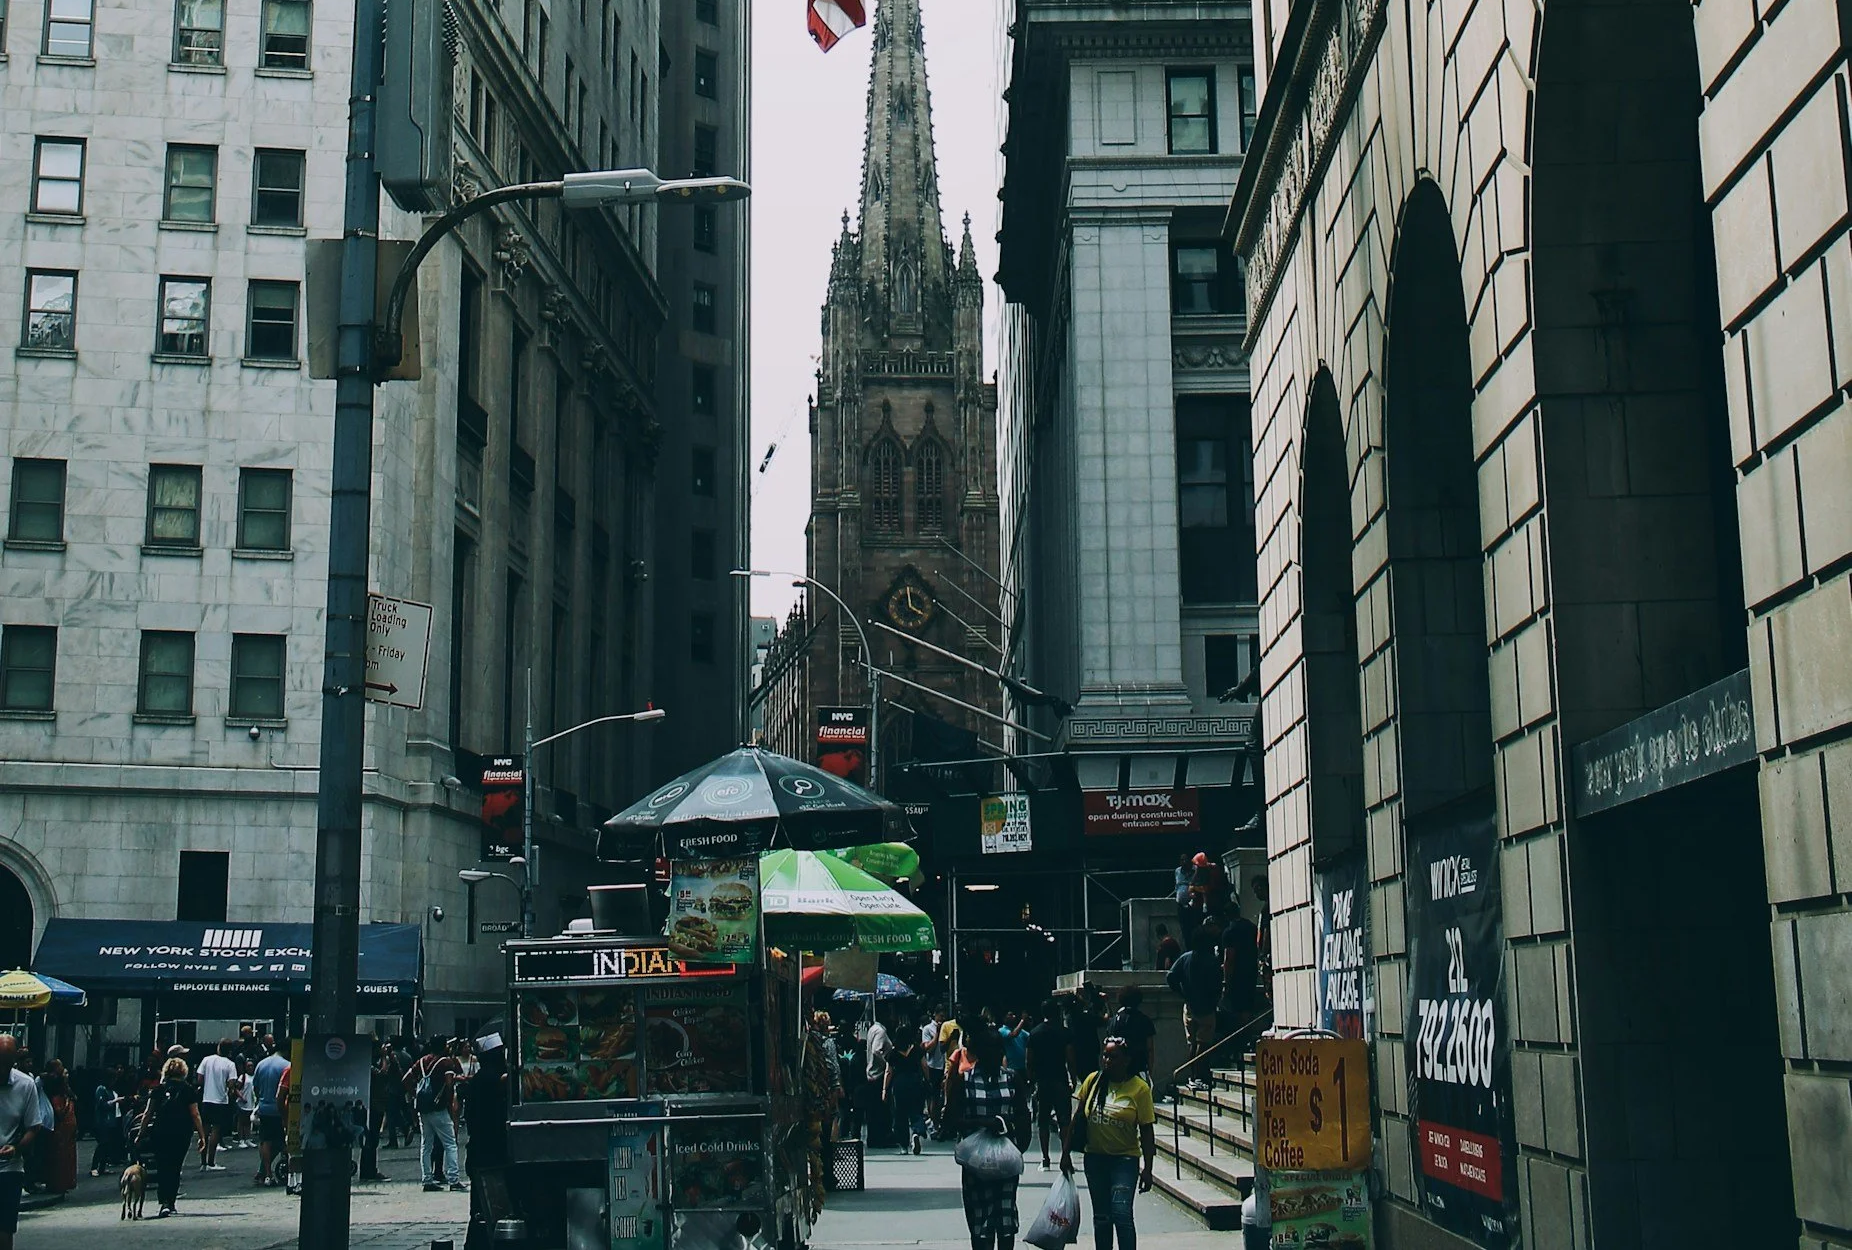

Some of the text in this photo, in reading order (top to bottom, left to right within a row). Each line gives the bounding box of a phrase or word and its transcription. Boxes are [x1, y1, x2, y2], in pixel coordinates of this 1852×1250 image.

[373, 599, 397, 613] Truck
[371, 611, 407, 629] Loading
[370, 622, 390, 637] Only
[378, 645, 405, 661] Friday
[832, 712, 853, 721] NYC
[819, 725, 866, 737] financial
[483, 770, 522, 780] financial
[1088, 810, 1193, 822] open during construction
[1122, 820, 1160, 828] entrance
[680, 833, 738, 848] FRESH FOOD
[886, 933, 912, 944] FOOD
[99, 946, 141, 956] NEW
[146, 945, 195, 956] YORK
[199, 948, 258, 958] STOCK
[124, 962, 181, 970] FOLLOW
[173, 982, 270, 992] EMPLOYEE ENTRANCE
[363, 985, 399, 994] GUESTS
[1416, 998, 1496, 1089] 792.2600
[1261, 1047, 1320, 1076] Can Soda
[1263, 1079, 1299, 1108] Water
[1264, 1110, 1286, 1139] Tea
[675, 1140, 760, 1154] Iced Cold Drinks
[1264, 1139, 1304, 1168] Coffee
